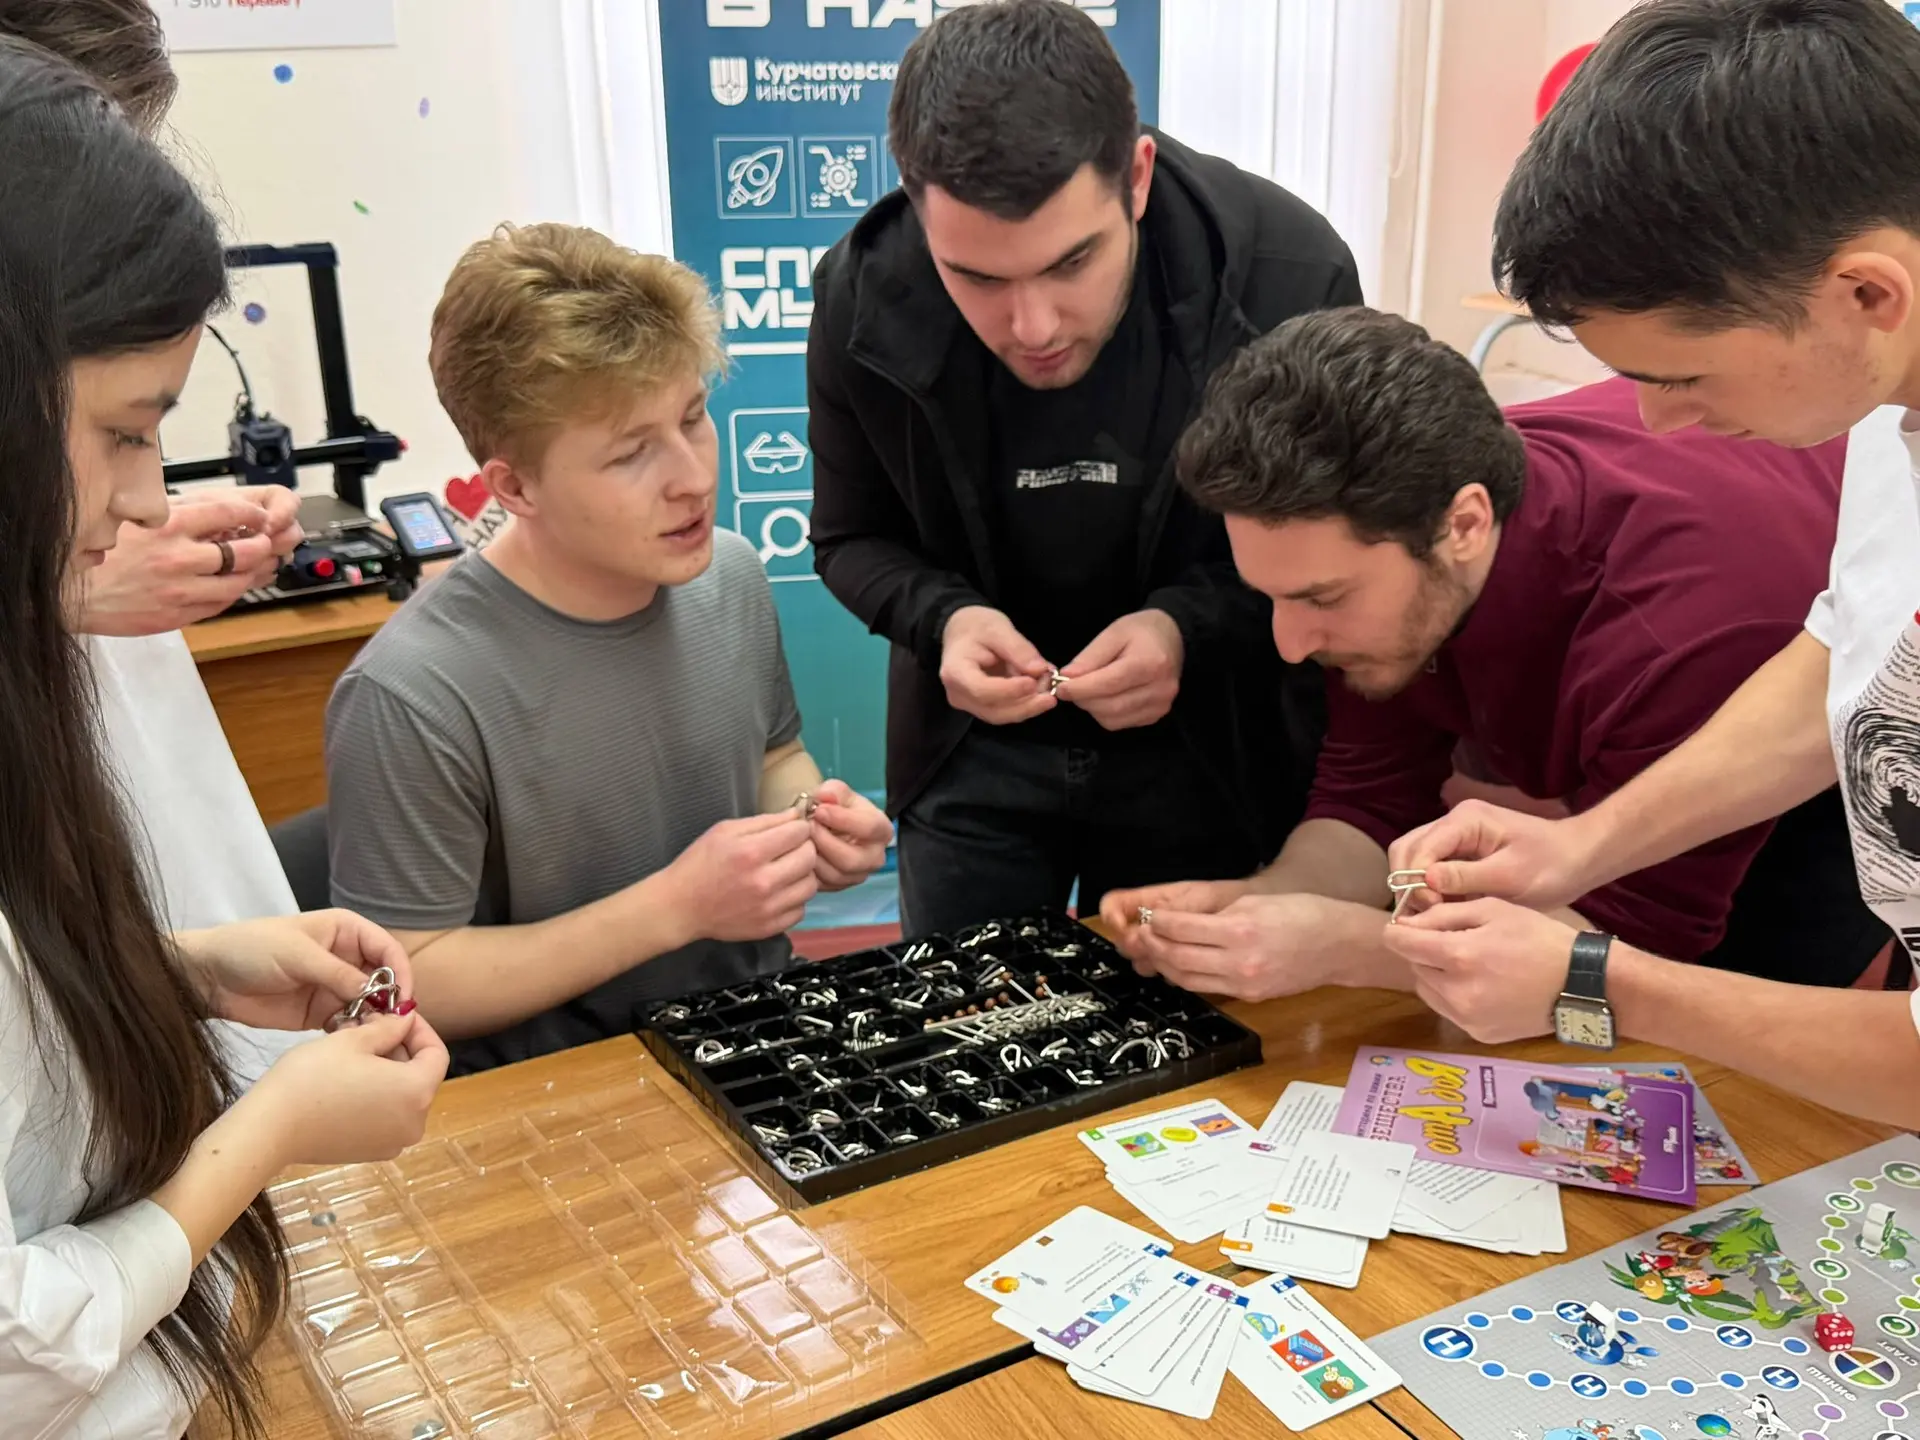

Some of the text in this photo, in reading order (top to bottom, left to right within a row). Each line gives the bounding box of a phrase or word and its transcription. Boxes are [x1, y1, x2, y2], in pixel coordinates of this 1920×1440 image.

[755, 83, 862, 106] институт
[721, 246, 830, 288] СП
[1876, 1340, 1918, 1366] СТАРТ
[1806, 1366, 1857, 1401] ФИНИШ
